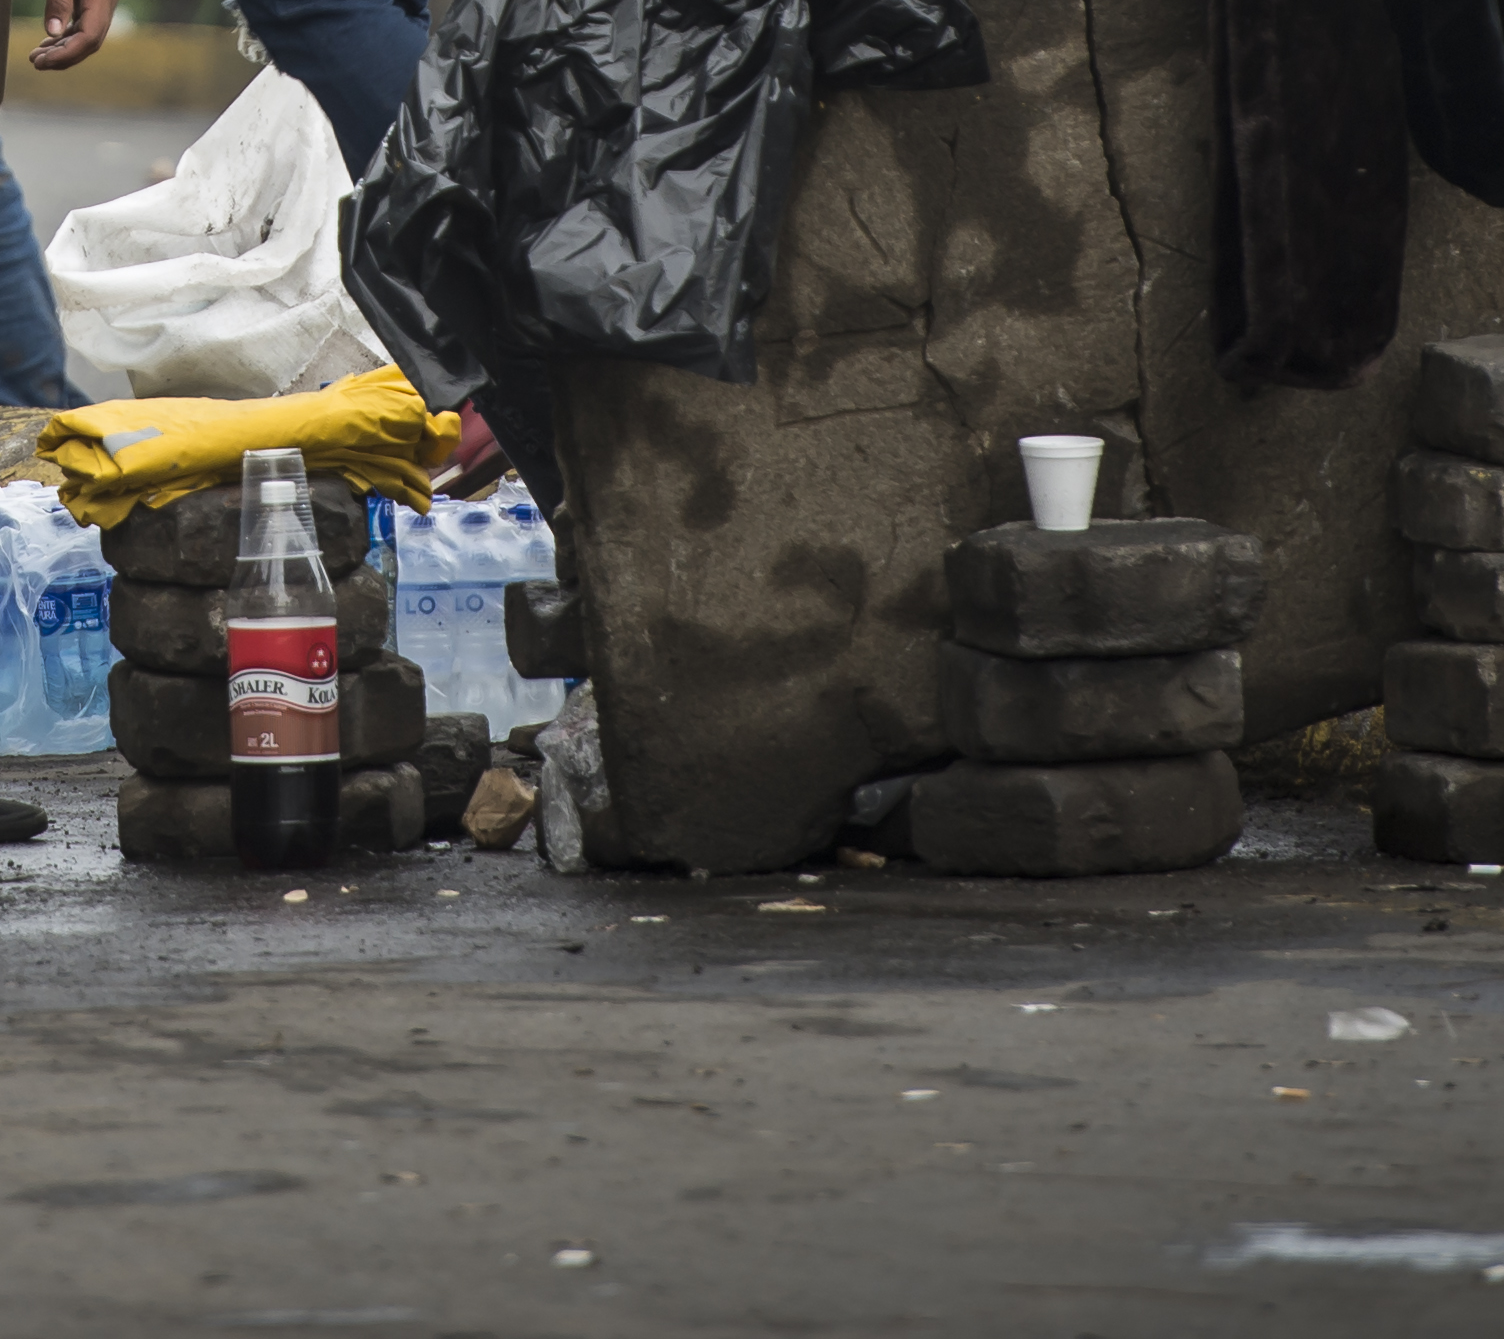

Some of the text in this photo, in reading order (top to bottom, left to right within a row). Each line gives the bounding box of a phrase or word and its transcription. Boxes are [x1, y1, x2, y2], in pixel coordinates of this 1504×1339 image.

[232, 679, 335, 704] SHALER KOLA
[260, 732, 279, 747] 2L
